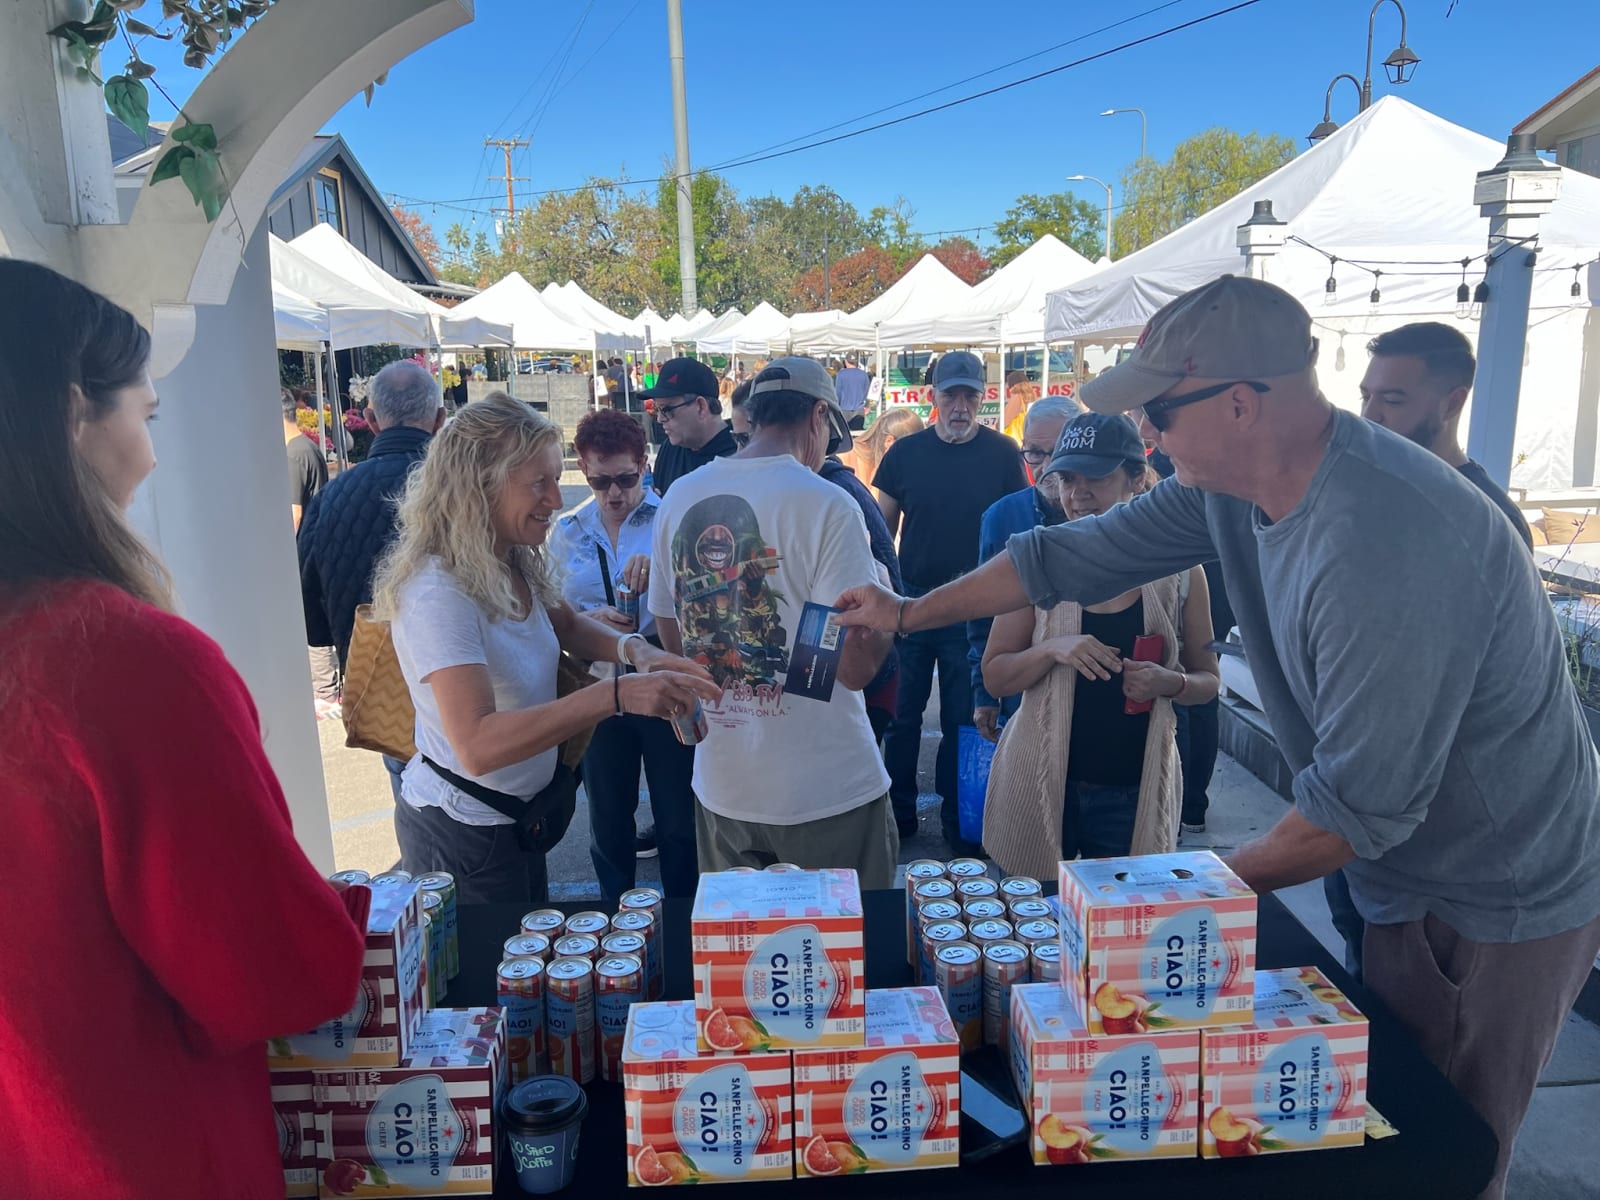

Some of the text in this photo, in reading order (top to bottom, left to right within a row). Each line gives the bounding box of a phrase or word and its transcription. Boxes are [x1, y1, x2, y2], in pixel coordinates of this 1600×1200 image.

[756, 708, 770, 718] ON
[752, 970, 760, 1001] ORANGE
[759, 972, 767, 999] BLOOD
[771, 953, 790, 1017] CIAO!
[802, 939, 814, 1030] SANPELLEGRINO
[1166, 935, 1184, 997] CIAO!
[1196, 920, 1207, 1009] SANPELLEGRINO
[870, 1080, 888, 1142] CIAO!
[901, 1065, 911, 1151] SANPELLEGRINO
[1109, 1070, 1127, 1130] CIAO!
[1140, 1055, 1150, 1141] SANPELLEGRINO
[1279, 1061, 1296, 1121] CIAO!
[1309, 1046, 1320, 1132] SANPELLEGRINO
[378, 1121, 387, 1149] CHERRY
[394, 1102, 414, 1165] CIAO!
[426, 1088, 441, 1176] SANPELLEGRINO
[700, 1091, 719, 1153] CIAO!
[731, 1077, 742, 1165] SANPELLEGRINO
[521, 1156, 554, 1169] COFFEE
